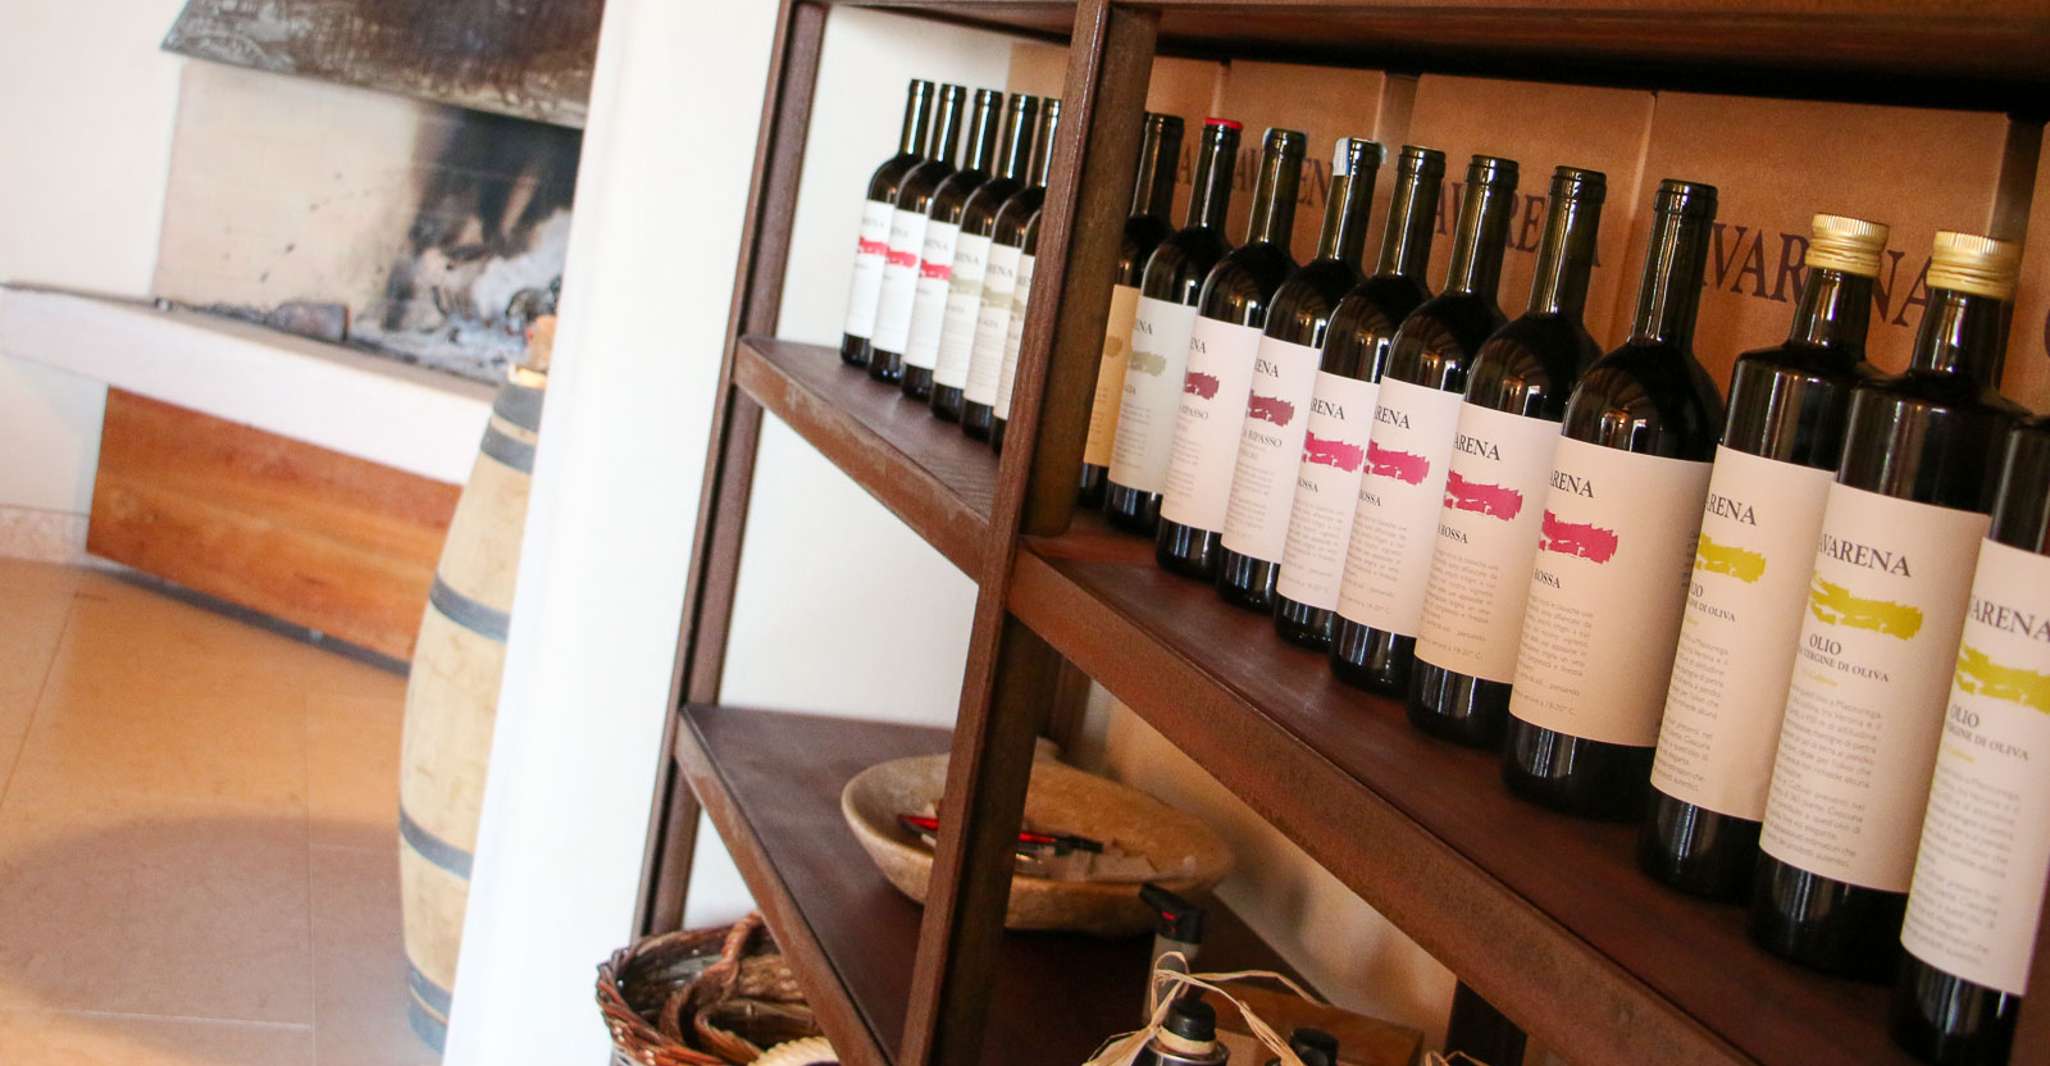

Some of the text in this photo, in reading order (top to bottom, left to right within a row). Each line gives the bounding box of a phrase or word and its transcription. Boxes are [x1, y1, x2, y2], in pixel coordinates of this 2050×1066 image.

[1809, 633, 1842, 656] OLIO
[1837, 660, 1850, 673] DI
[1851, 664, 1889, 683] OLIVA
[1989, 740, 2029, 762] OLIVA
